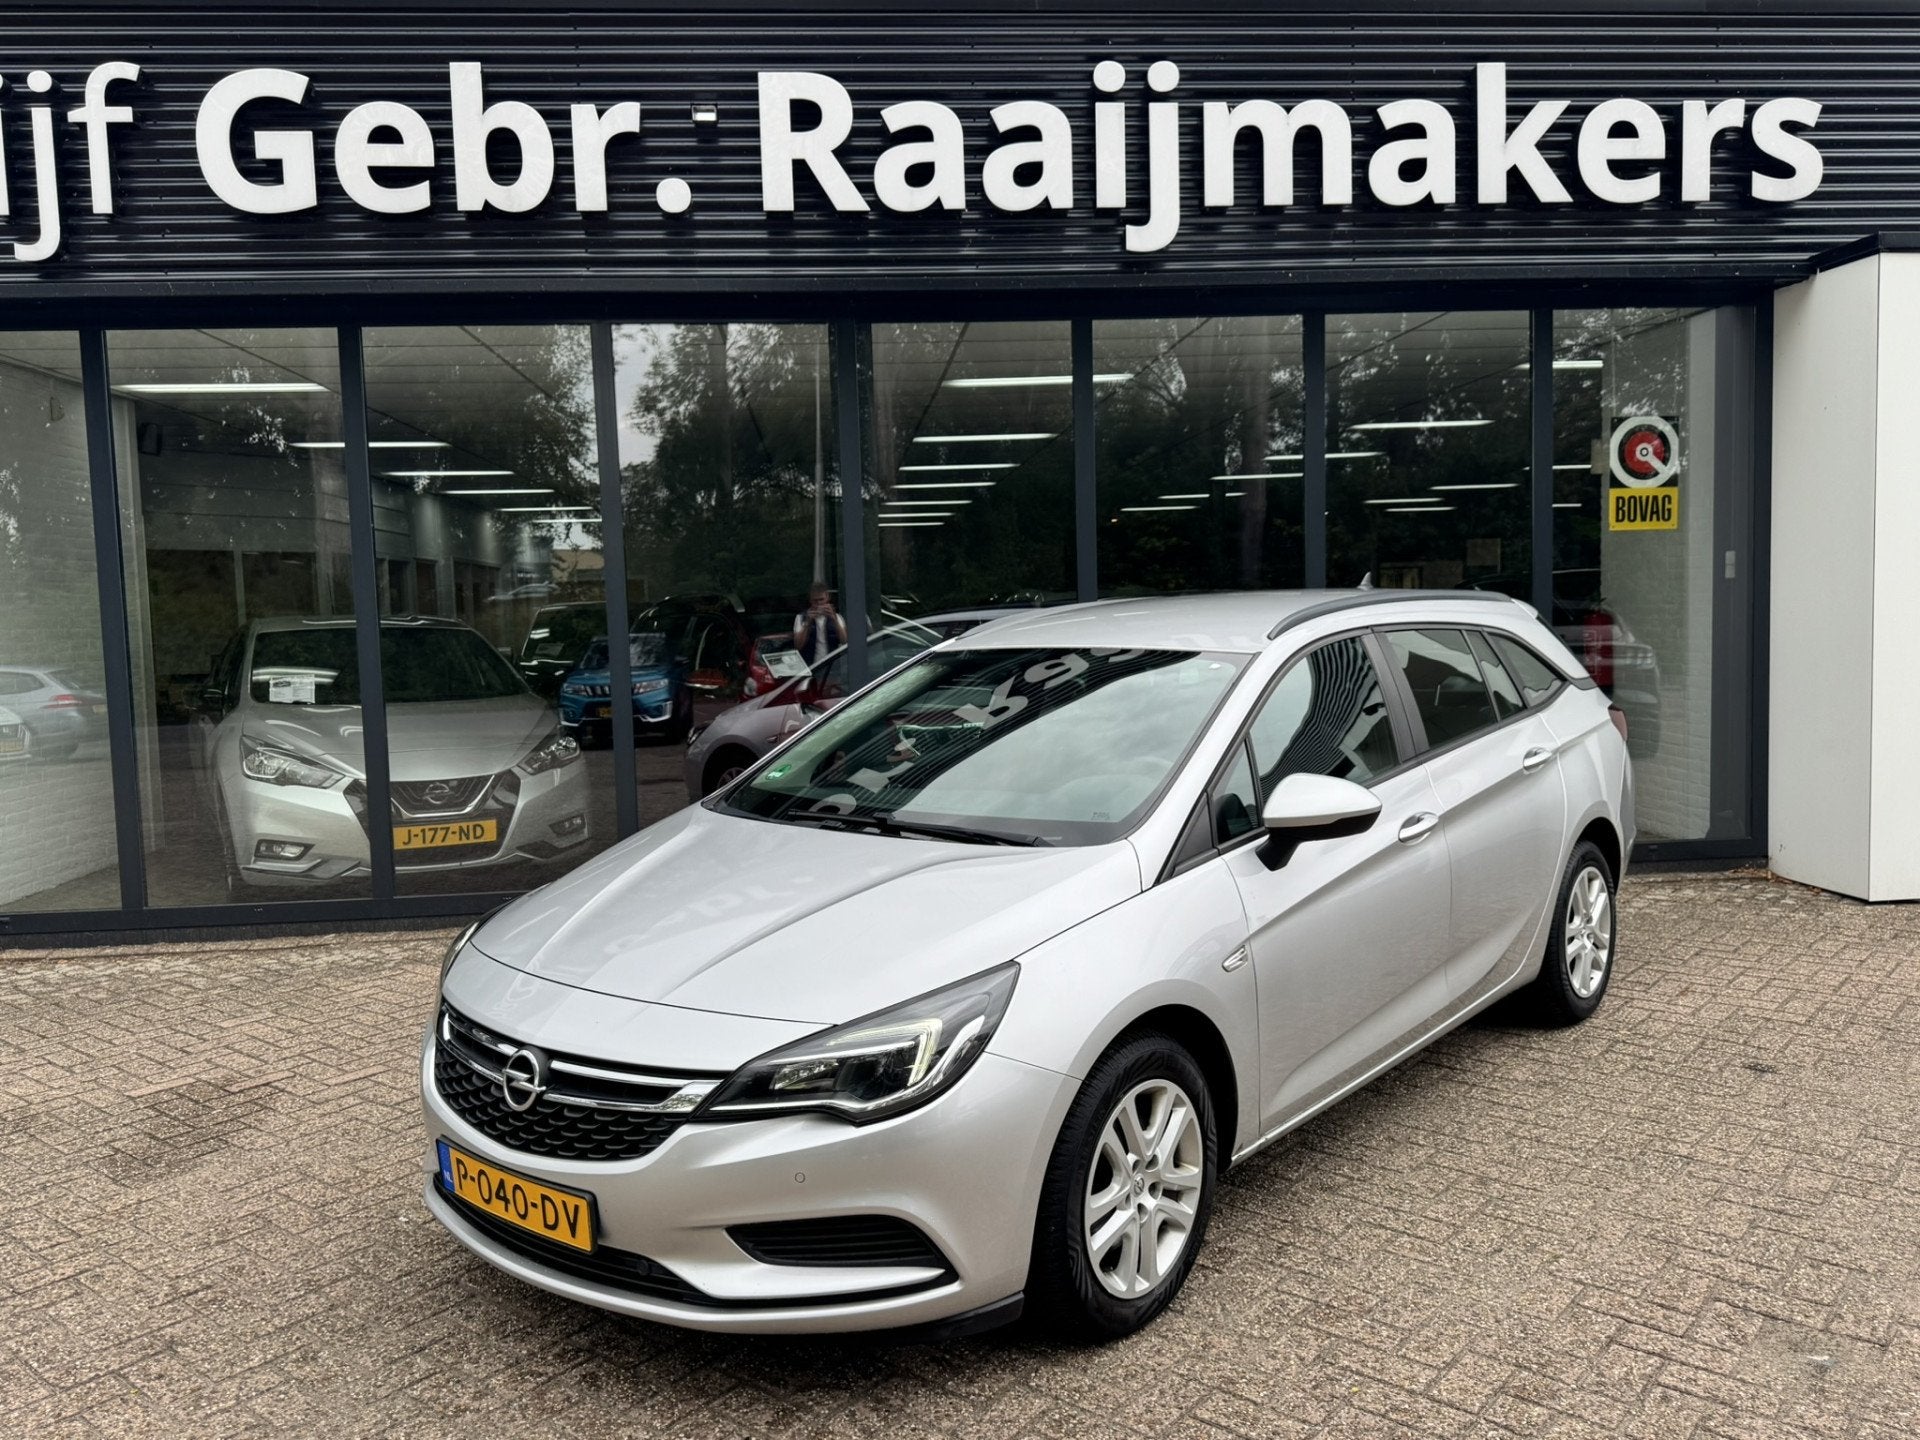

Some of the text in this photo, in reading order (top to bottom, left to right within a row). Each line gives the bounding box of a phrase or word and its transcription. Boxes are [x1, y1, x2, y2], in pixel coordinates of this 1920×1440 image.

[196, 62, 692, 213] Gebr.
[758, 60, 1824, 252] Raaijmakers
[1615, 494, 1672, 523] BOVAG
[402, 823, 485, 846] J-177-ND
[455, 1157, 580, 1239] P-040-DV
